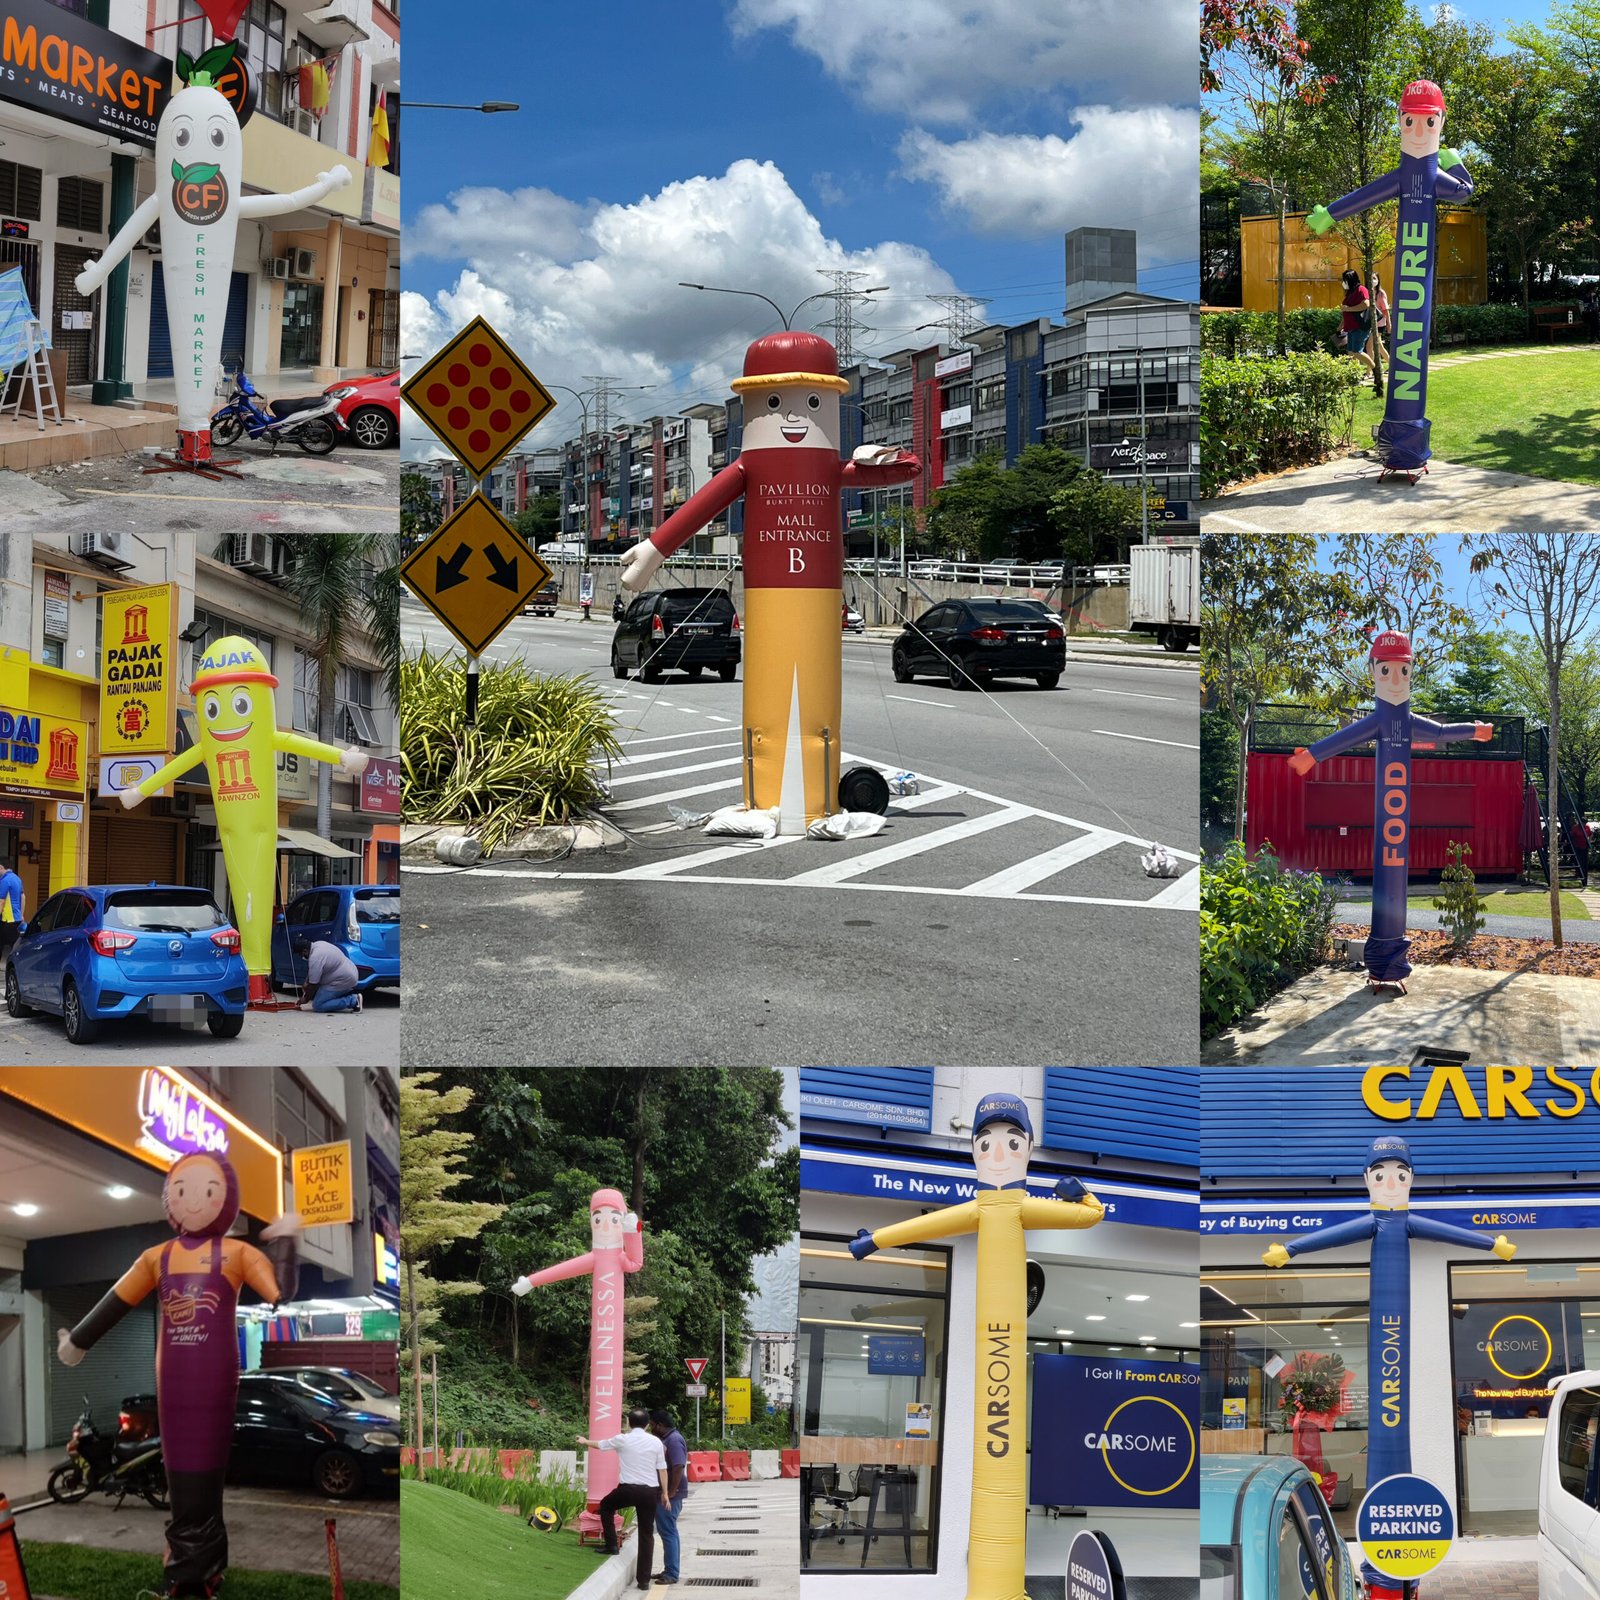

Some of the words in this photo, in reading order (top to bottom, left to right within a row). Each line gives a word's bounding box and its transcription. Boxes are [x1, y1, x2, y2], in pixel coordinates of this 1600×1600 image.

[39, 81, 84, 106] MEATS
[103, 105, 157, 131] SEAFOOD
[182, 184, 220, 209] CF
[194, 233, 205, 296] FRESH
[1393, 221, 1429, 401] NATURE
[193, 314, 205, 389] MARKET
[759, 484, 831, 496] PAVILION
[777, 514, 816, 527] MALL
[759, 530, 832, 543] ENTRANCE
[787, 547, 806, 574] B
[108, 643, 163, 664] PAJAK
[196, 651, 257, 672] PAJAK
[107, 661, 163, 682] GADAI
[106, 683, 132, 697] RANTAU
[132, 680, 162, 694] PANJANG
[124, 707, 143, 732] 當
[217, 792, 260, 802] PAWNZON
[1382, 761, 1408, 867] FOOD
[1361, 1066, 1600, 1121] CARS
[813, 1095, 837, 1106] OLEH
[842, 1099, 884, 1113] CARSOME
[979, 1101, 1021, 1113] CARSOME
[1373, 1143, 1407, 1151] CARSOME
[300, 1153, 344, 1173] BUTIK
[305, 1168, 340, 1185] KAIN
[873, 1174, 904, 1191] The
[909, 1178, 950, 1195] New
[305, 1190, 340, 1206] LACE
[1220, 1216, 1236, 1228] of
[1239, 1216, 1288, 1230] Buying
[1292, 1215, 1323, 1227] Cars
[1472, 1213, 1537, 1225] CARSOME
[1476, 1340, 1539, 1352] CARSOME
[1085, 1367, 1089, 1378] I
[1092, 1367, 1113, 1380] Got
[1115, 1368, 1122, 1380] It
[1125, 1369, 1156, 1383] From
[1381, 1315, 1401, 1428] CARSOME
[986, 1322, 1011, 1459] CARSOME
[1522, 1388, 1544, 1398] Buying
[1084, 1432, 1177, 1453] CARSOME
[1369, 1504, 1443, 1518] RESERVED
[1370, 1520, 1442, 1535] PARKING
[1376, 1548, 1437, 1560] CARSOME
[1071, 1562, 1107, 1595] RESERVED
